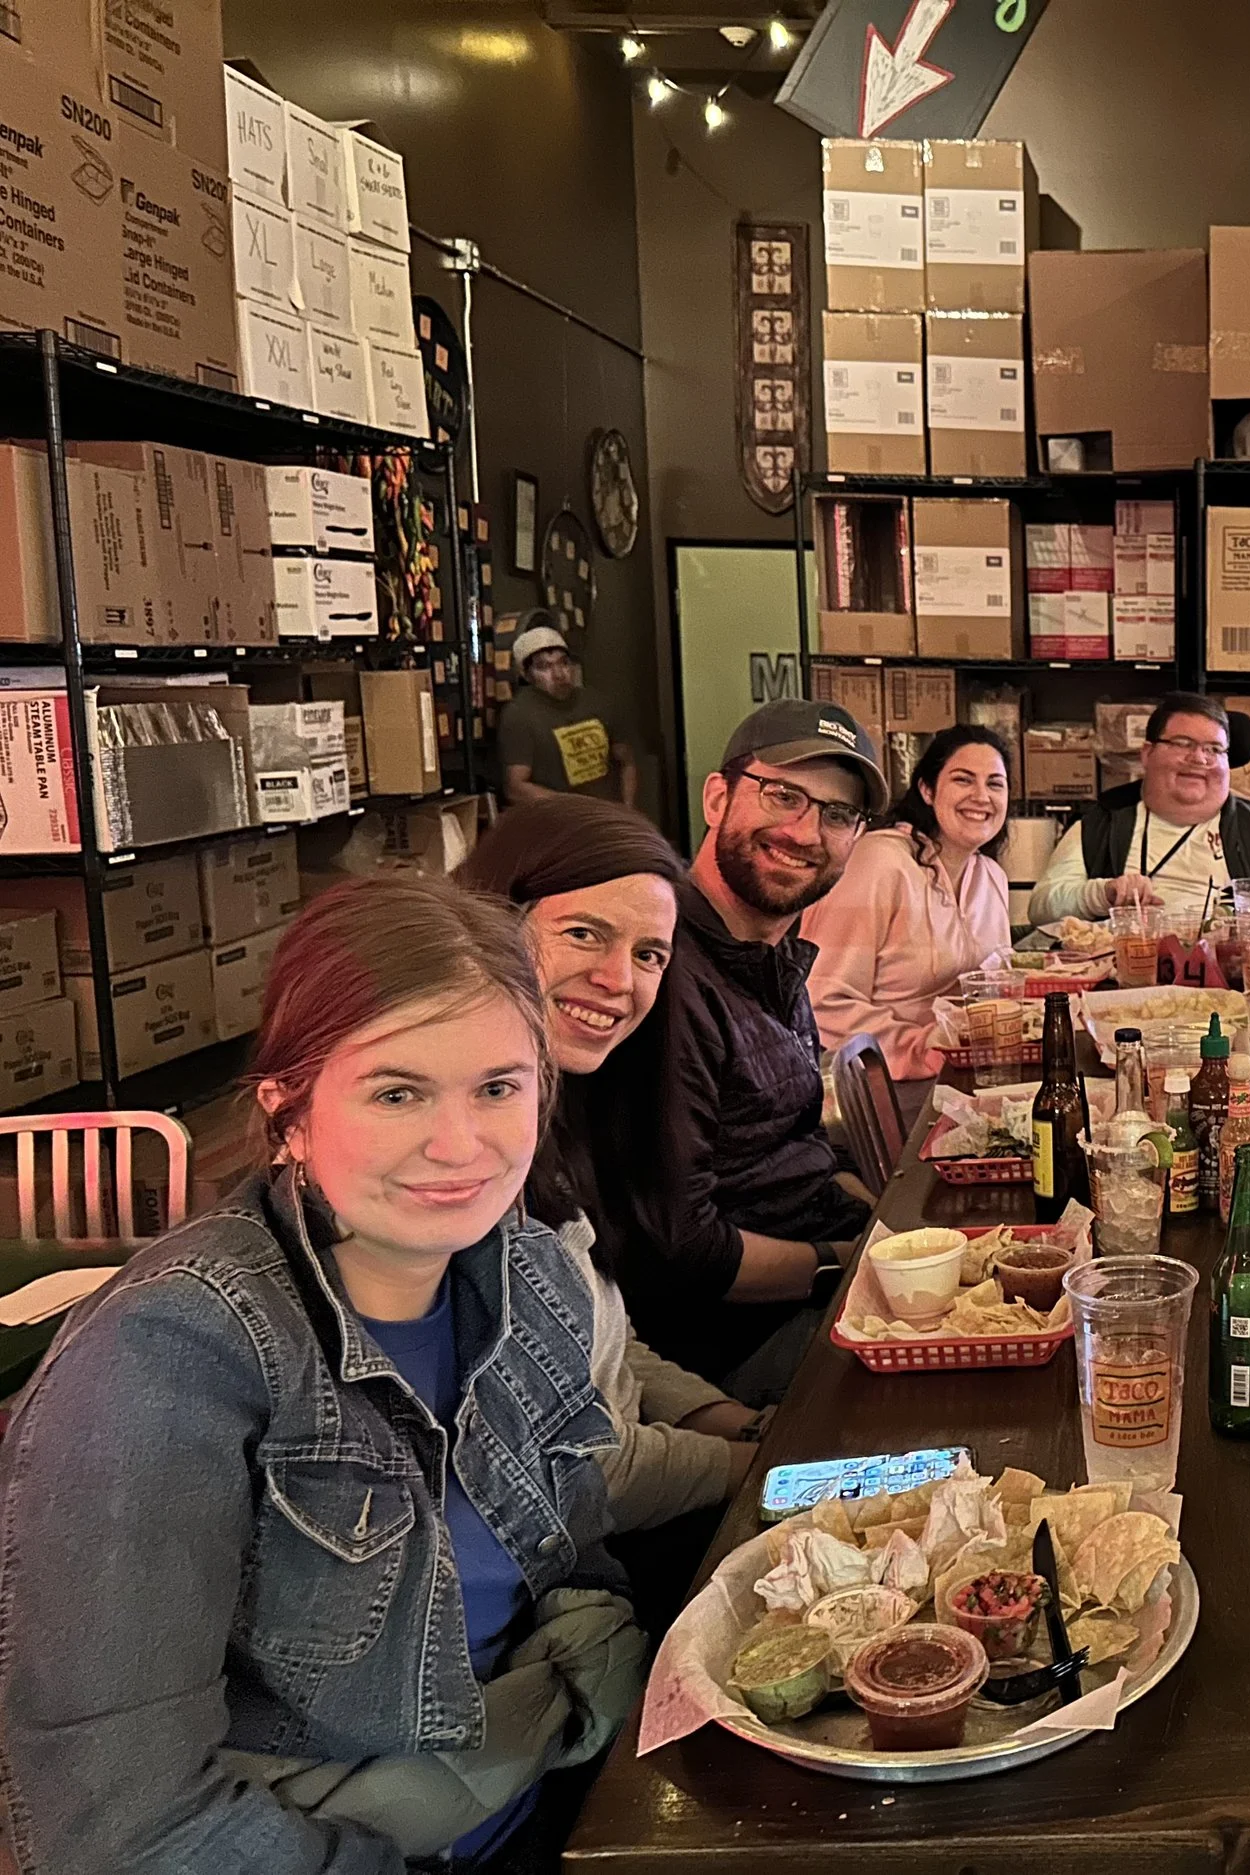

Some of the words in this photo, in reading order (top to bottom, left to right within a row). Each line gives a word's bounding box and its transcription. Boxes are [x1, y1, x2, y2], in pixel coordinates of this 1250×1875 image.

[61, 94, 112, 142] SN200
[237, 111, 273, 151] HATS
[0, 123, 44, 159] enpak
[11, 186, 56, 223] Hinged
[136, 192, 181, 228] Genpak
[245, 213, 278, 267] XL
[154, 253, 190, 281] Hinged
[142, 273, 197, 307] Containers
[265, 333, 298, 373] XXL
[30, 701, 43, 738] STEAM
[42, 701, 57, 763] ALUMINUM
[33, 741, 46, 774] TABLE
[61, 746, 76, 795] Classic
[36, 776, 49, 799] PAN
[264, 780, 294, 789] BLACK
[1108, 1409, 1157, 1424] MAMA
